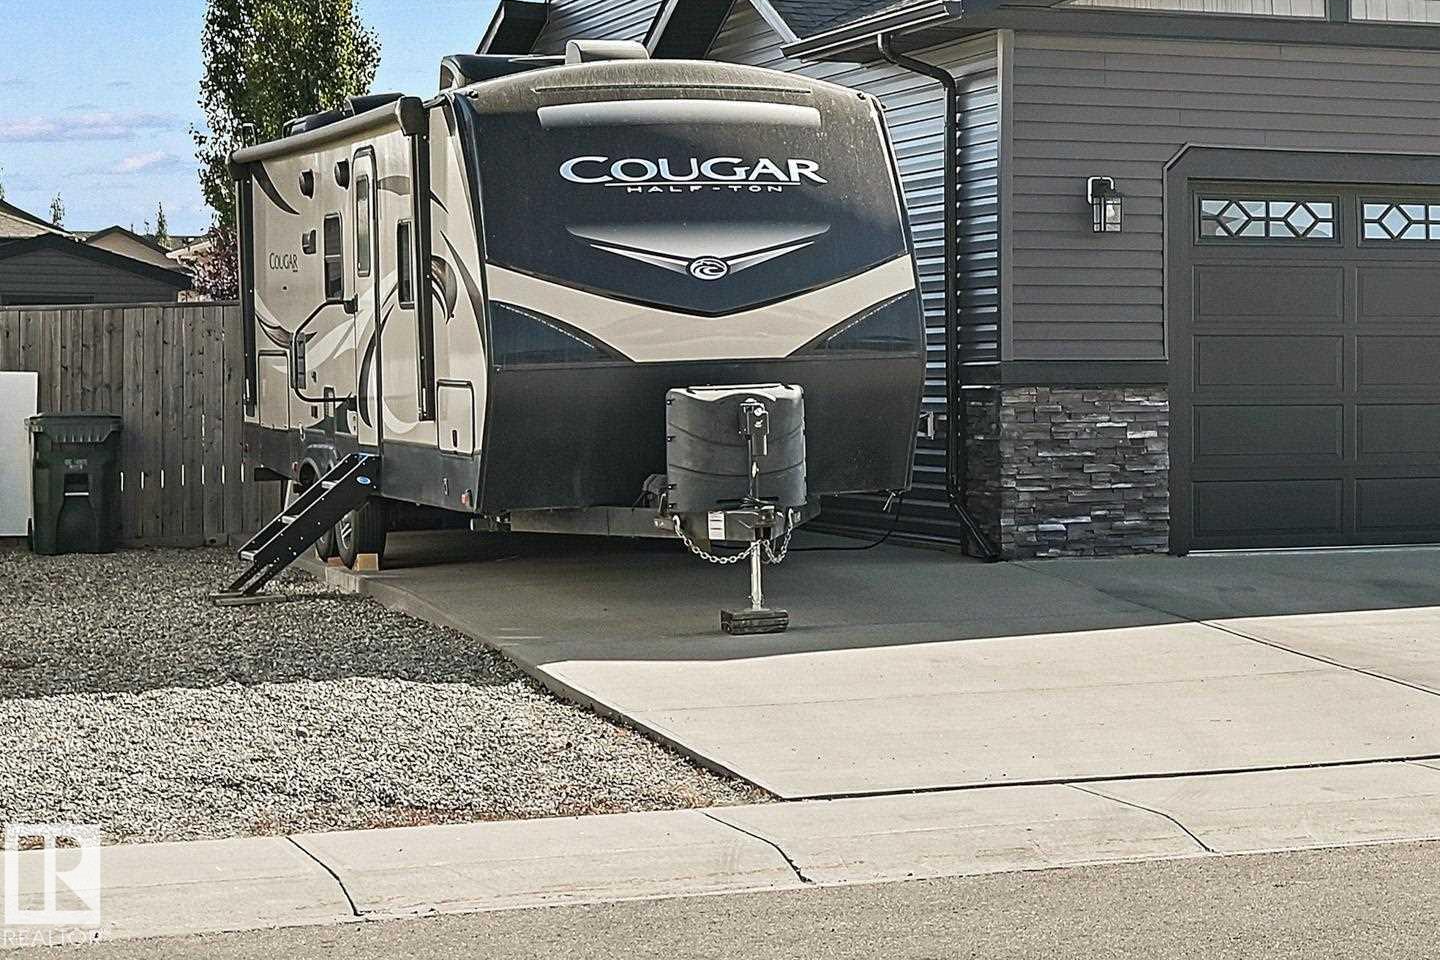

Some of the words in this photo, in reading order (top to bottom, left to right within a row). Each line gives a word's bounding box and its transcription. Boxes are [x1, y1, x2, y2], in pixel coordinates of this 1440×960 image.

[559, 156, 828, 184] COUGAR
[627, 185, 783, 193] HALF-TON
[269, 252, 298, 270] COUGAR
